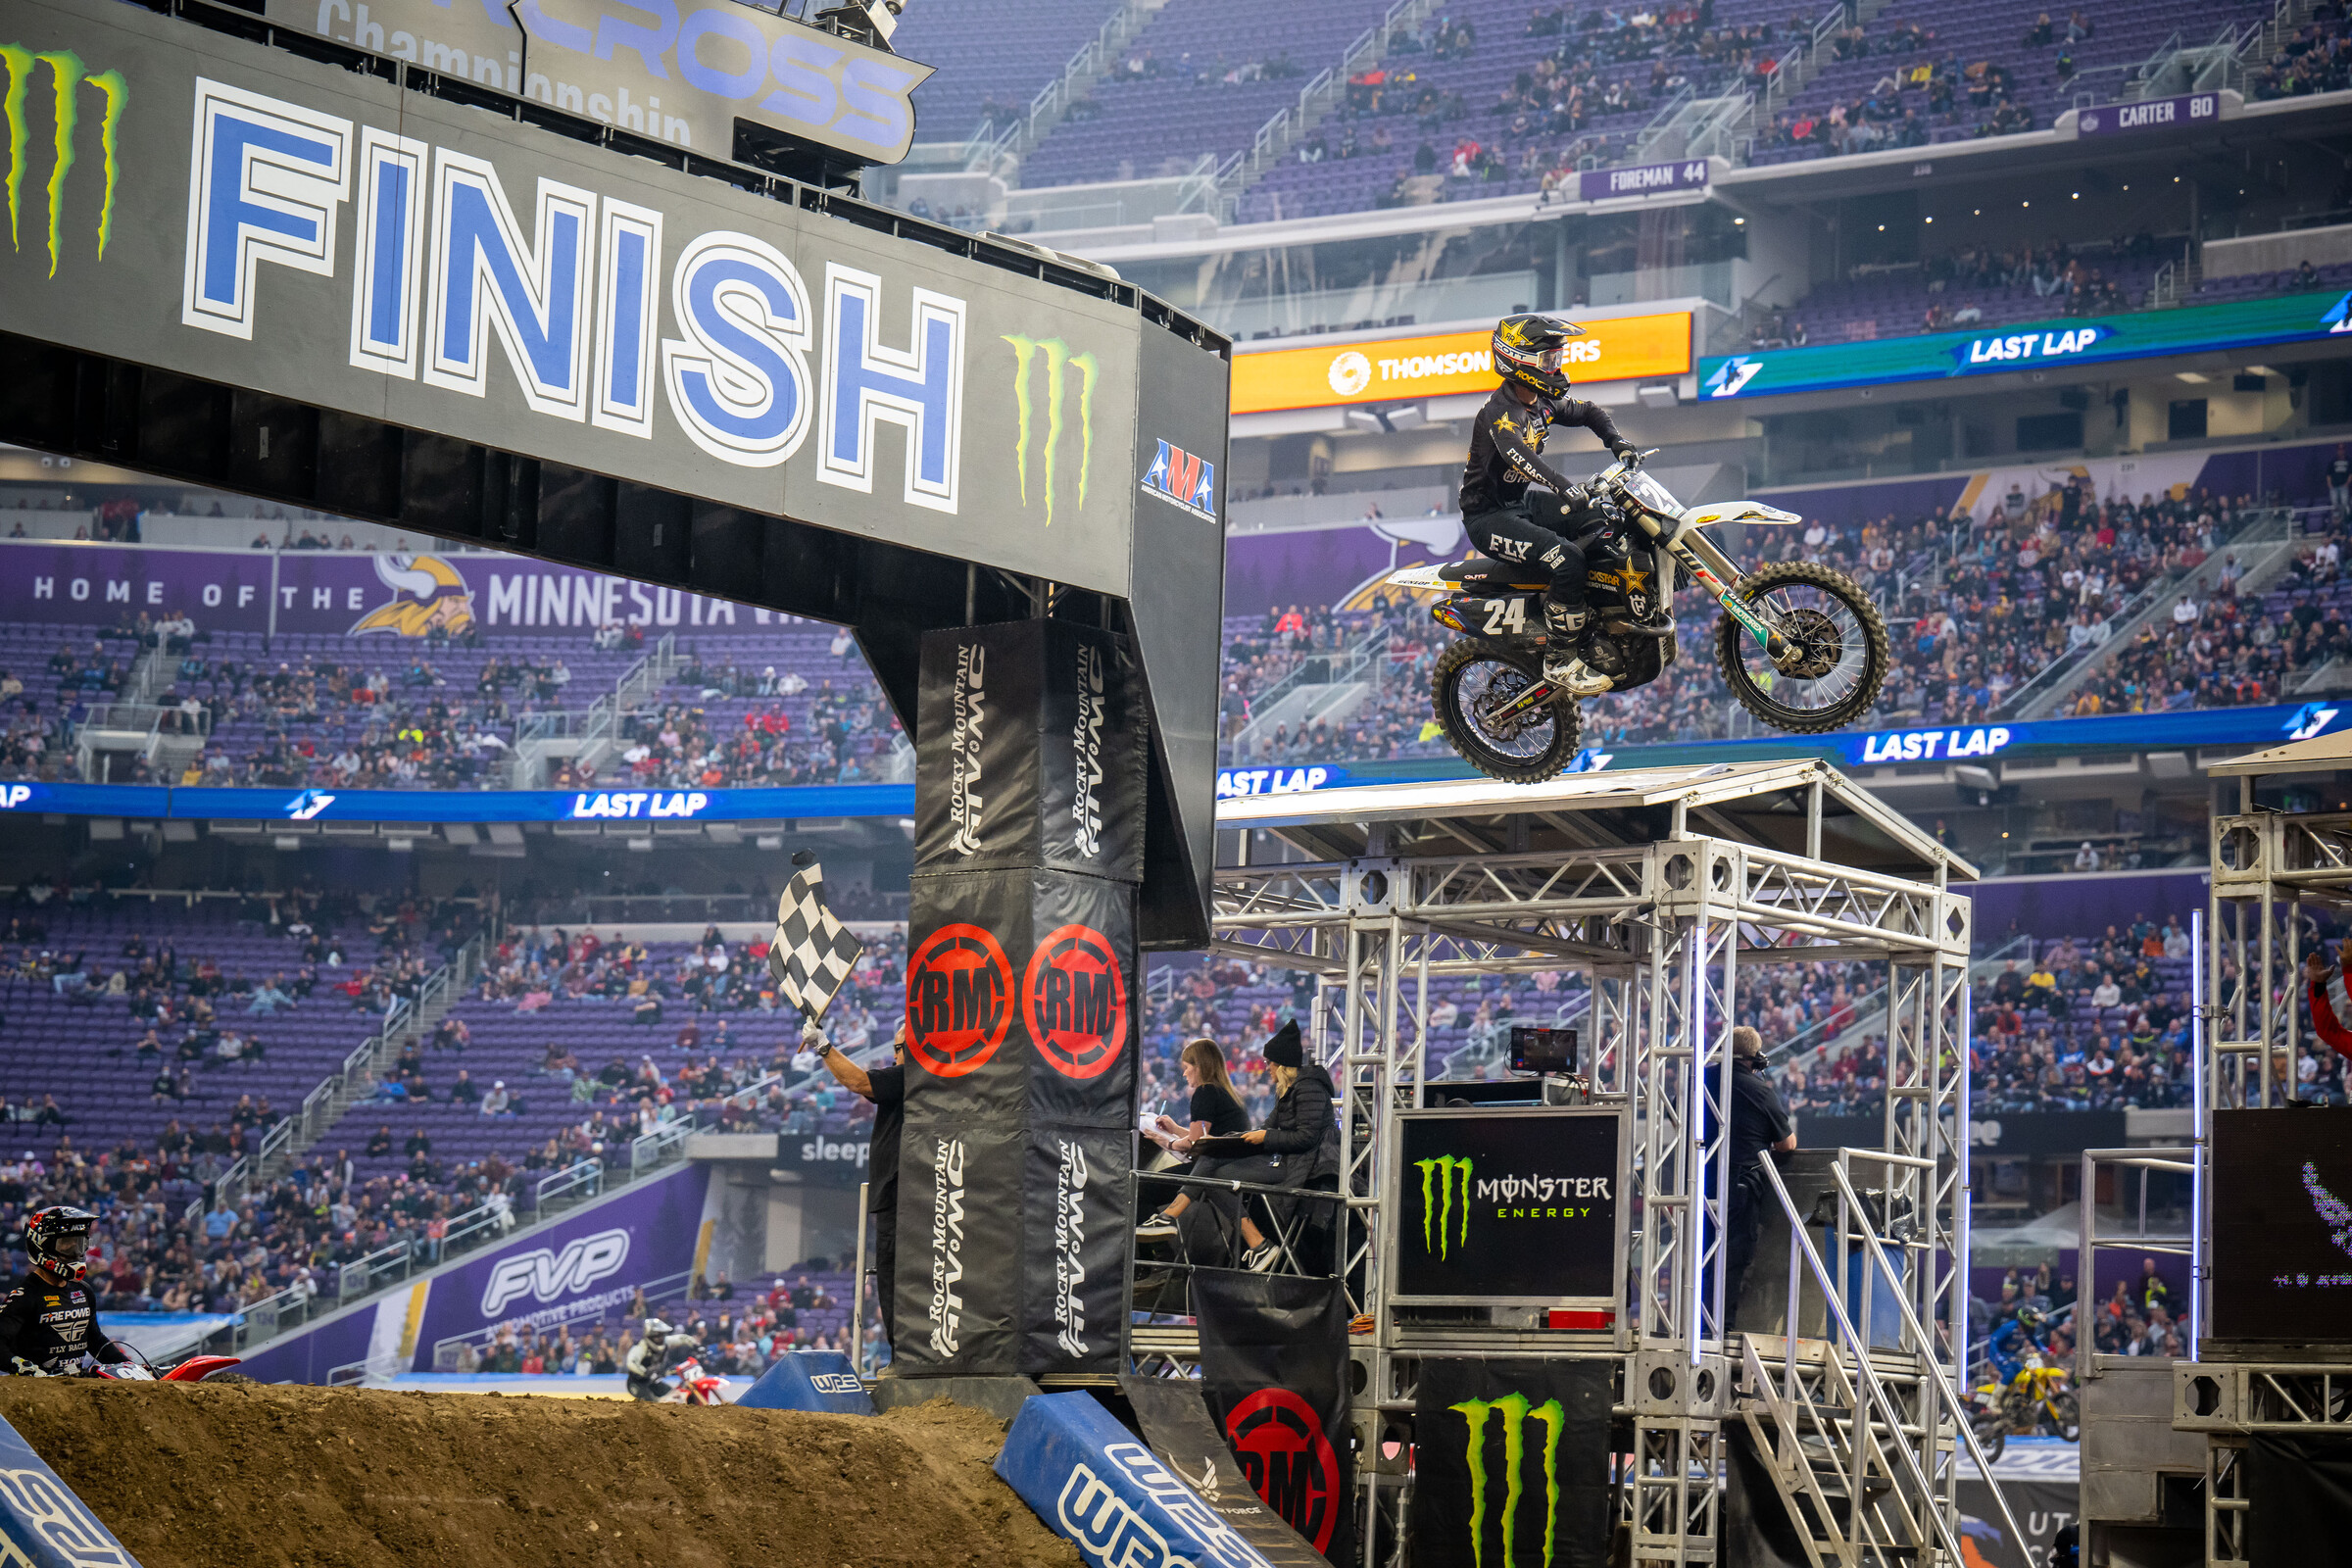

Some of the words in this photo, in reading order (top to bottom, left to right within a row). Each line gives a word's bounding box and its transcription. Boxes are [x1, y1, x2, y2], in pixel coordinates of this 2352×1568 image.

[2119, 101, 2175, 127] CARTER
[2190, 96, 2213, 119] 80
[1610, 166, 1674, 191] FOREMAN
[1683, 162, 1705, 182] 44
[182, 76, 966, 514] FINISH
[1970, 334, 2039, 363] LAST
[2042, 328, 2096, 356] LAP
[1378, 350, 1491, 380] THOMSON
[1506, 447, 1525, 466] FLY
[1141, 437, 1216, 515] AMA
[1489, 533, 1534, 562] FLY
[34, 576, 165, 605] HOME
[202, 584, 255, 608] OF
[280, 586, 364, 611] THE
[1588, 569, 1620, 587] CKSTAR
[1483, 598, 1526, 635] 24
[1732, 605, 1765, 634] MOTOREX
[952, 644, 970, 755] MOUNTAIN
[1073, 644, 1089, 754] MOUNTAIN
[1863, 732, 1944, 762] LAST
[1947, 727, 2010, 757] LAP
[950, 757, 965, 825] ROCKY
[1072, 755, 1087, 825] ROCKY
[1217, 770, 1269, 797] AST
[1271, 767, 1327, 793] LAP
[573, 794, 647, 817] LAST
[650, 793, 708, 816] LAP
[802, 1135, 870, 1168] sleep
[932, 1139, 951, 1253] MOUNTAIN
[1055, 1138, 1073, 1253] MOUNTAIN
[1477, 1173, 1612, 1203] MONSTER
[1497, 1207, 1591, 1218] ENERGY
[26, 1227, 48, 1246] FLY
[37, 1252, 69, 1277] froth
[480, 1228, 630, 1318] FVP
[929, 1255, 945, 1324] ROCKY
[1054, 1255, 1067, 1325] ROCKY
[65, 1306, 91, 1320] POWE
[49, 1346, 67, 1354] FLY
[809, 1373, 862, 1394] WPS
[1057, 1463, 1198, 1568] WP
[1227, 1506, 1263, 1515] FORCE
